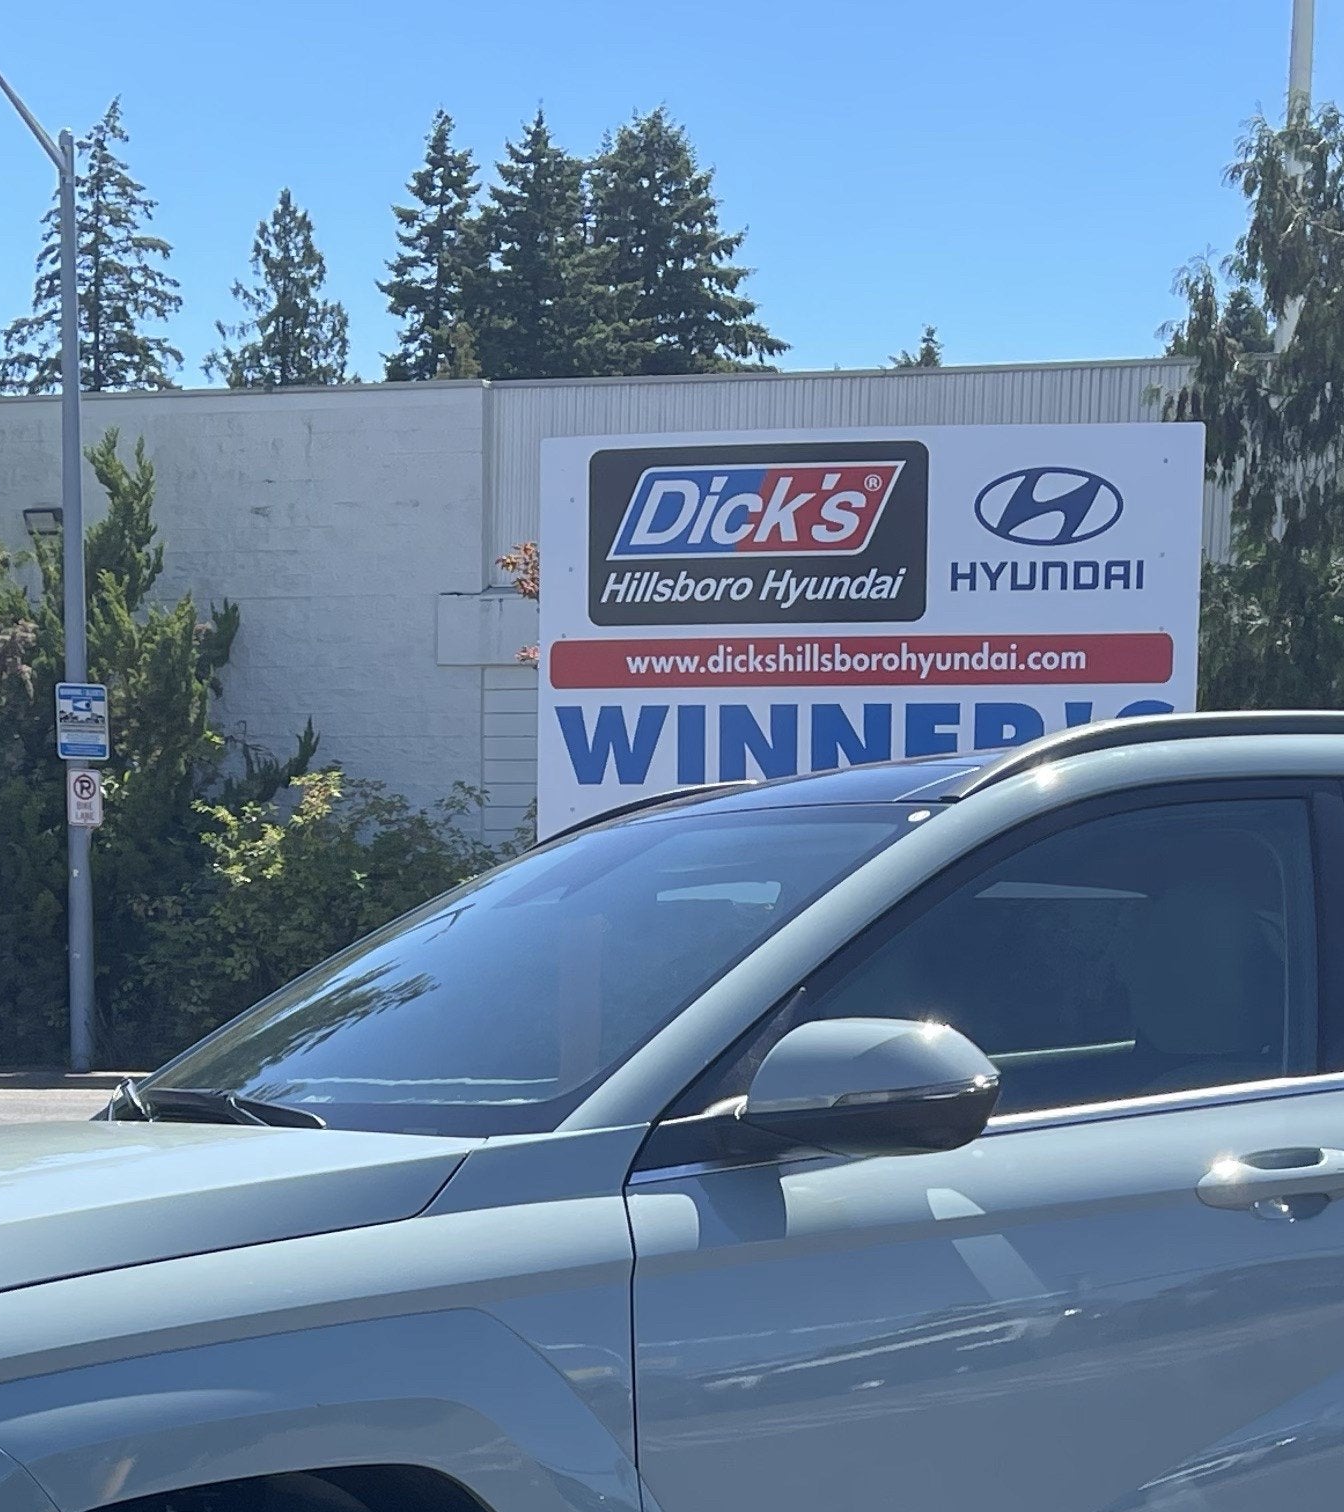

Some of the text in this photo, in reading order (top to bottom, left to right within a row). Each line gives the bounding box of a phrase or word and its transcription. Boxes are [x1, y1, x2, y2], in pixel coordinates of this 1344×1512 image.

[629, 472, 868, 546] Dick's
[601, 567, 906, 609] Hillsboro Hyundai
[950, 559, 1144, 592] HYUNDAI
[625, 641, 1087, 680] www.dickshillsborohyundai.com
[554, 699, 1175, 785] WINNER'
